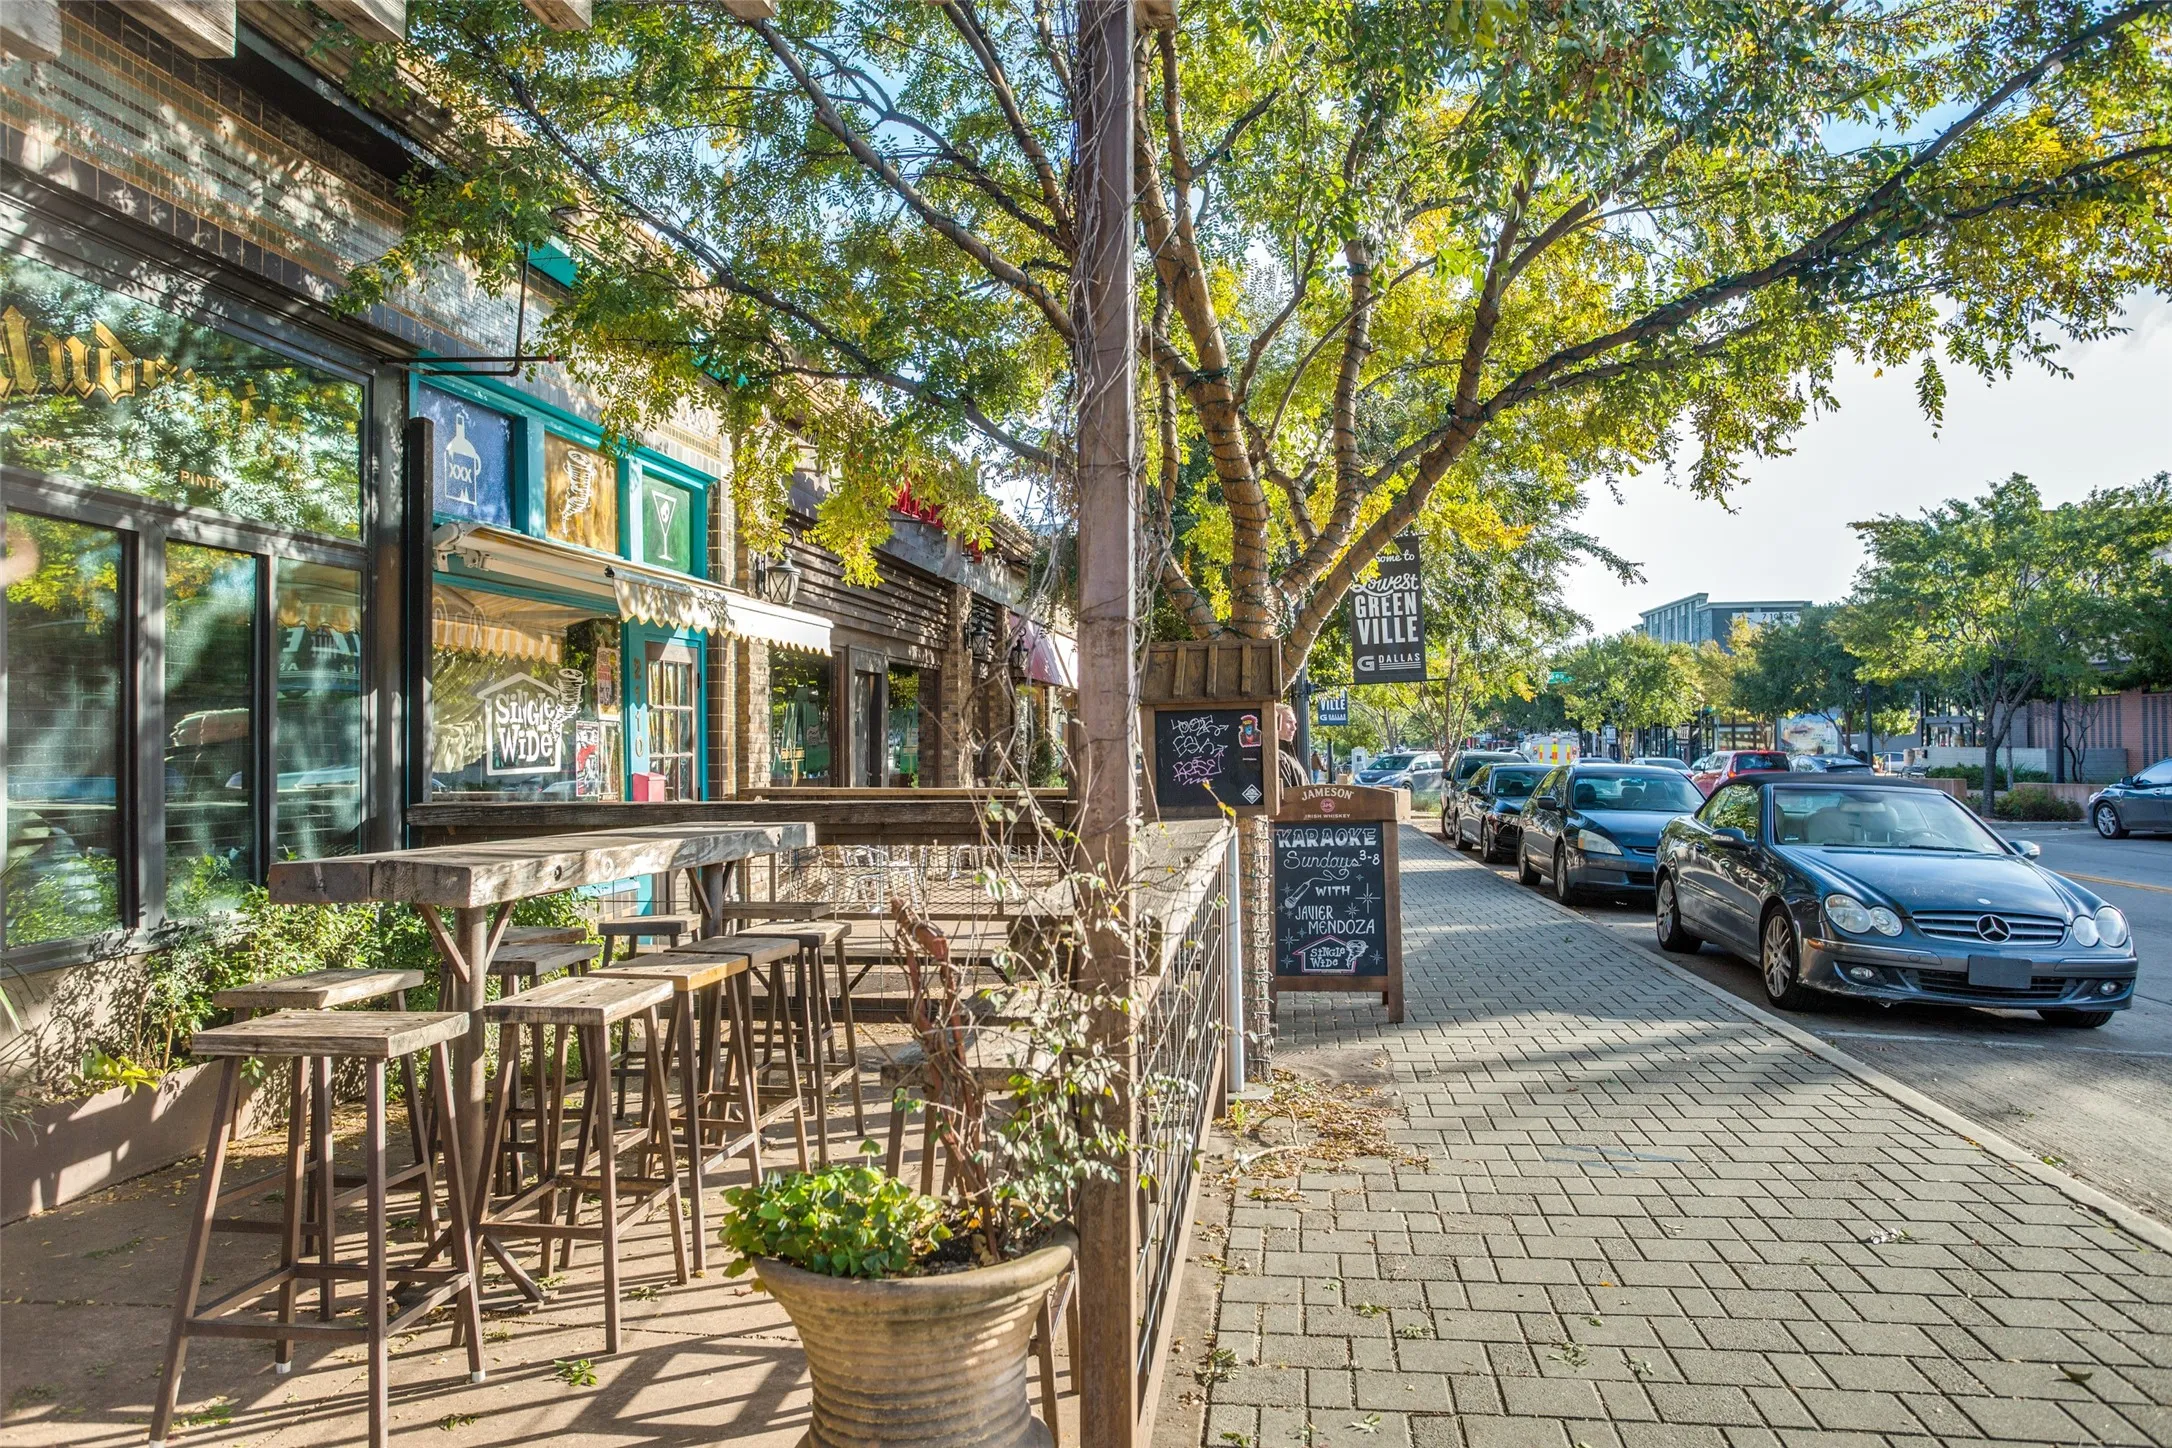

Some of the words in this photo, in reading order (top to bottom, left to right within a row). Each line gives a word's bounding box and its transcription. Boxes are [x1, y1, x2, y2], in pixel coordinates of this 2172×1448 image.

[180, 469, 224, 491] PINTS
[449, 462, 473, 484] XXX
[1402, 549, 1415, 561] to
[1354, 591, 1417, 619] GREEN
[1357, 616, 1419, 645] VILLE
[1378, 652, 1421, 663] DALLAS
[1320, 699, 1346, 711] VILLE
[1301, 787, 1353, 801] JAMESON
[1276, 828, 1377, 848] KARAOKE
[1283, 850, 1362, 876] Sundays
[1359, 849, 1380, 866] 3-8
[1315, 886, 1351, 897] WITH
[1295, 905, 1334, 921] JAVIER
[1308, 919, 1375, 935] MENDOZA
